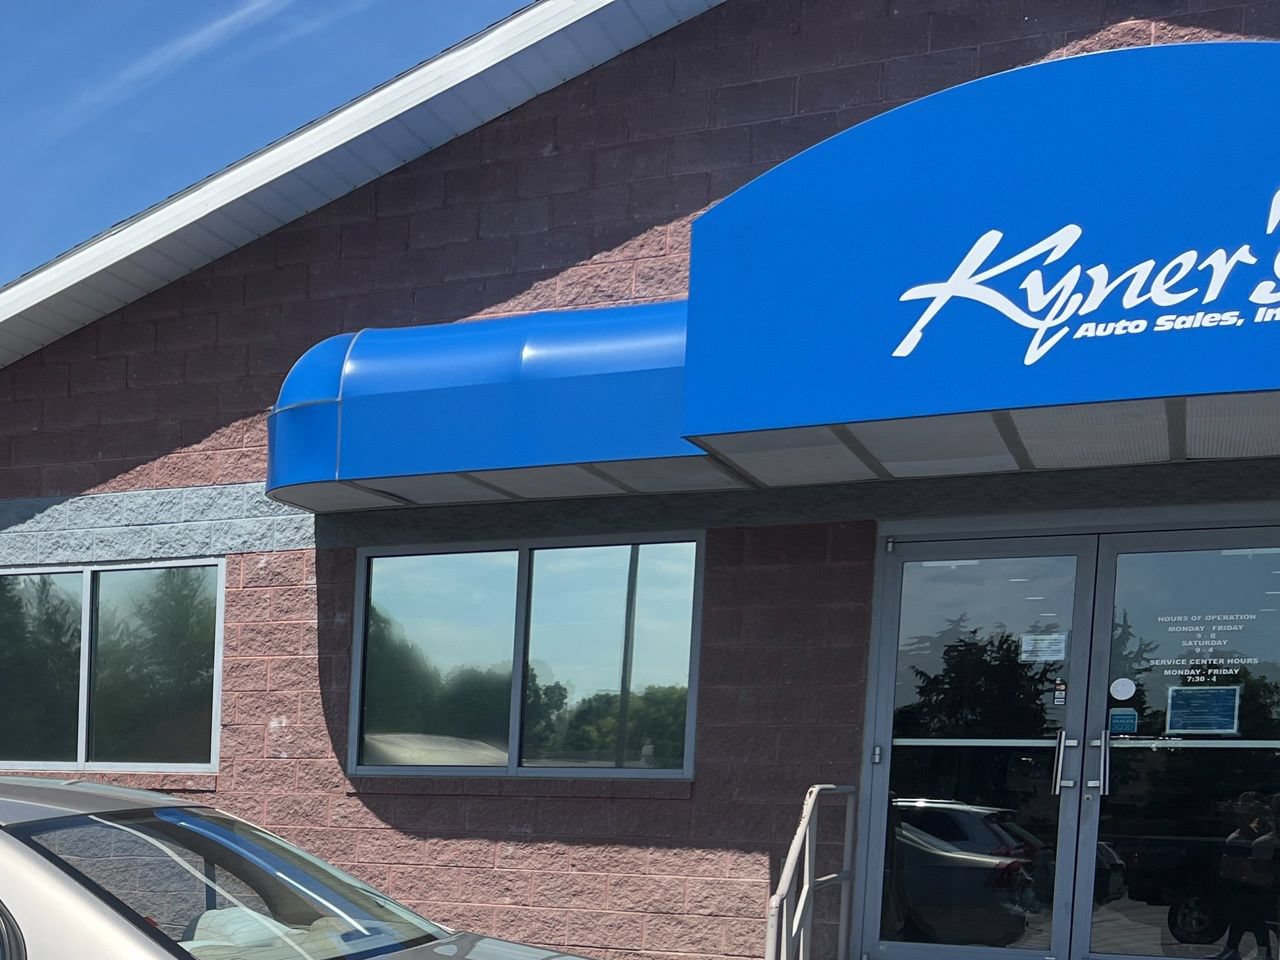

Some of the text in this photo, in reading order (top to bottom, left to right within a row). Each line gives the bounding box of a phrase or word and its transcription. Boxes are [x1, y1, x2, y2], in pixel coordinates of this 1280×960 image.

[1073, 319, 1148, 339] Auto
[1153, 310, 1245, 331] Sales,
[1181, 639, 1229, 647] SATURDAY
